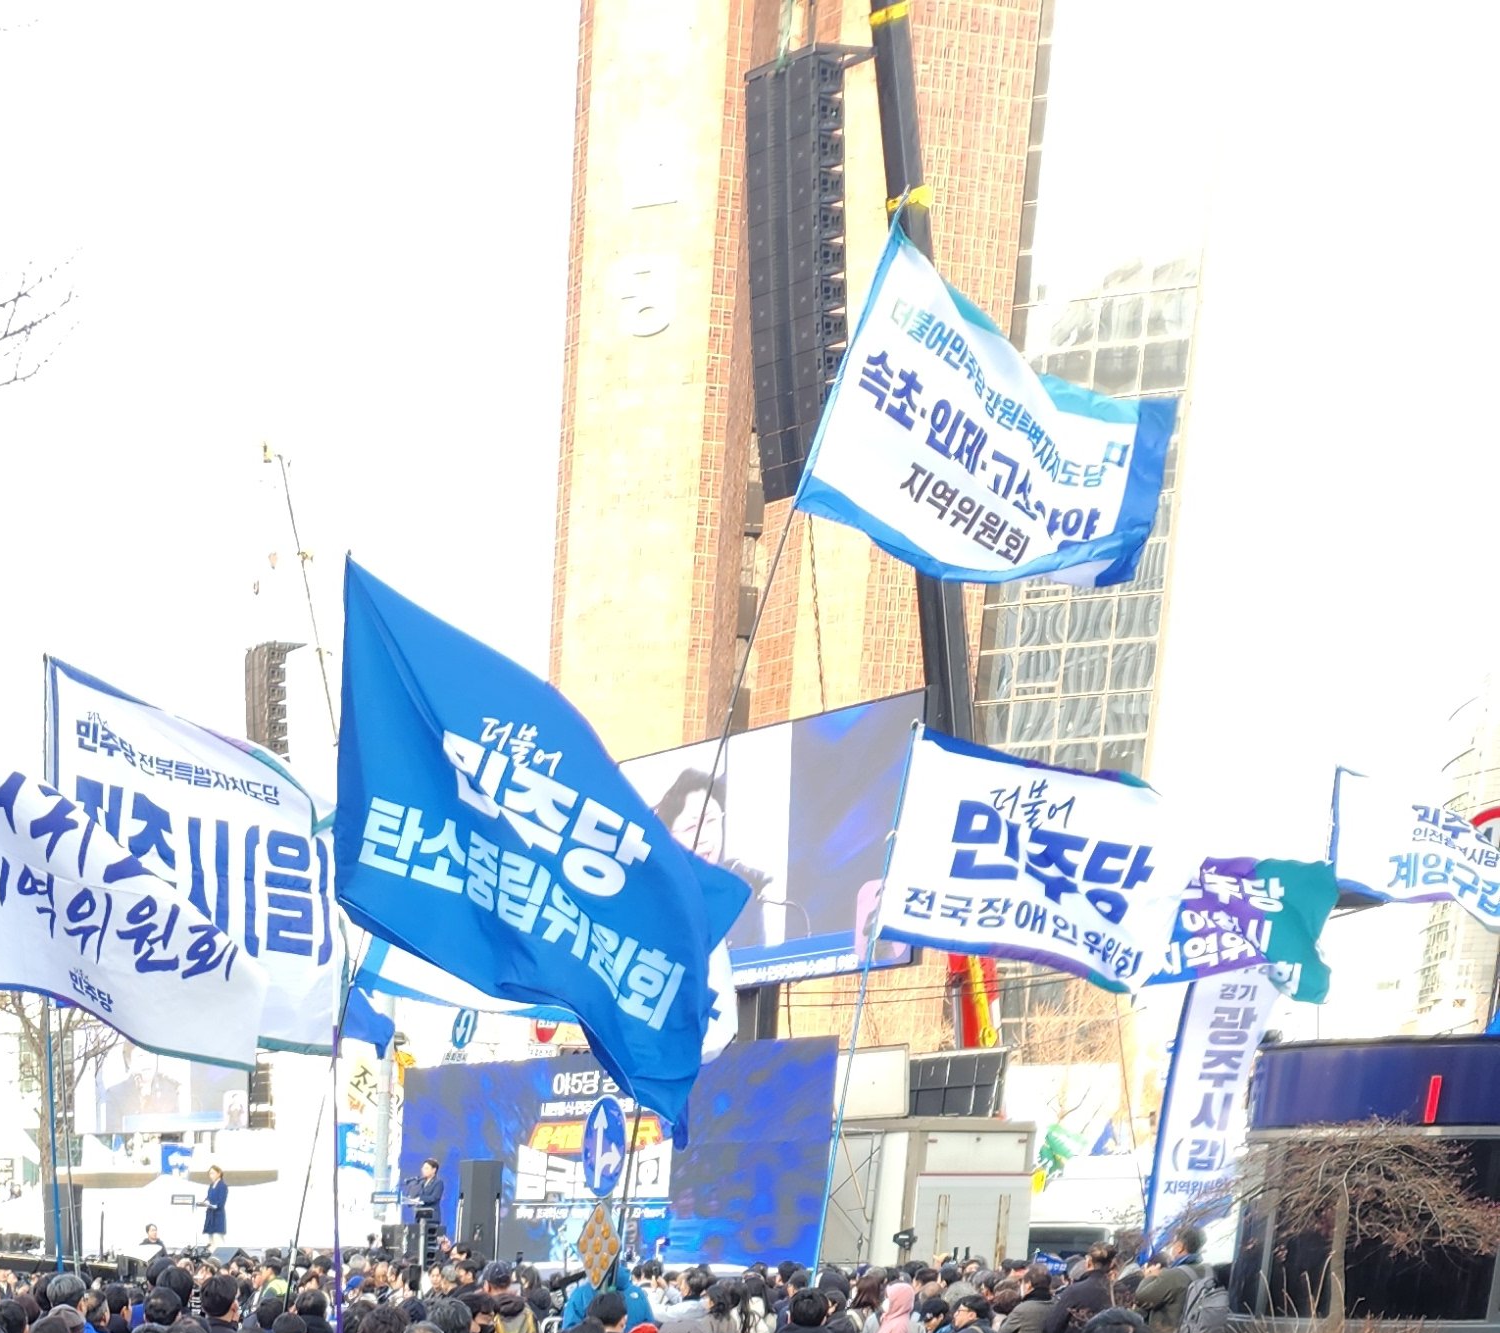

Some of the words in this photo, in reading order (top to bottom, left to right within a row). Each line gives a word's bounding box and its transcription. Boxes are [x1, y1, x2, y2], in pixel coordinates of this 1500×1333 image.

[900, 461, 1032, 566] 지역위원회
[75, 718, 138, 767] 민주당
[137, 749, 281, 806] 전북특별자치도당
[481, 716, 563, 777] 더불어
[443, 729, 653, 898] 민주당
[990, 779, 1077, 831] 더불어
[949, 799, 1156, 925] 민주당
[1181, 869, 1285, 913] 주당
[358, 796, 686, 1031] 탄소중립위원회
[69, 969, 114, 1013] 민주당
[1219, 983, 1257, 1003] 경기
